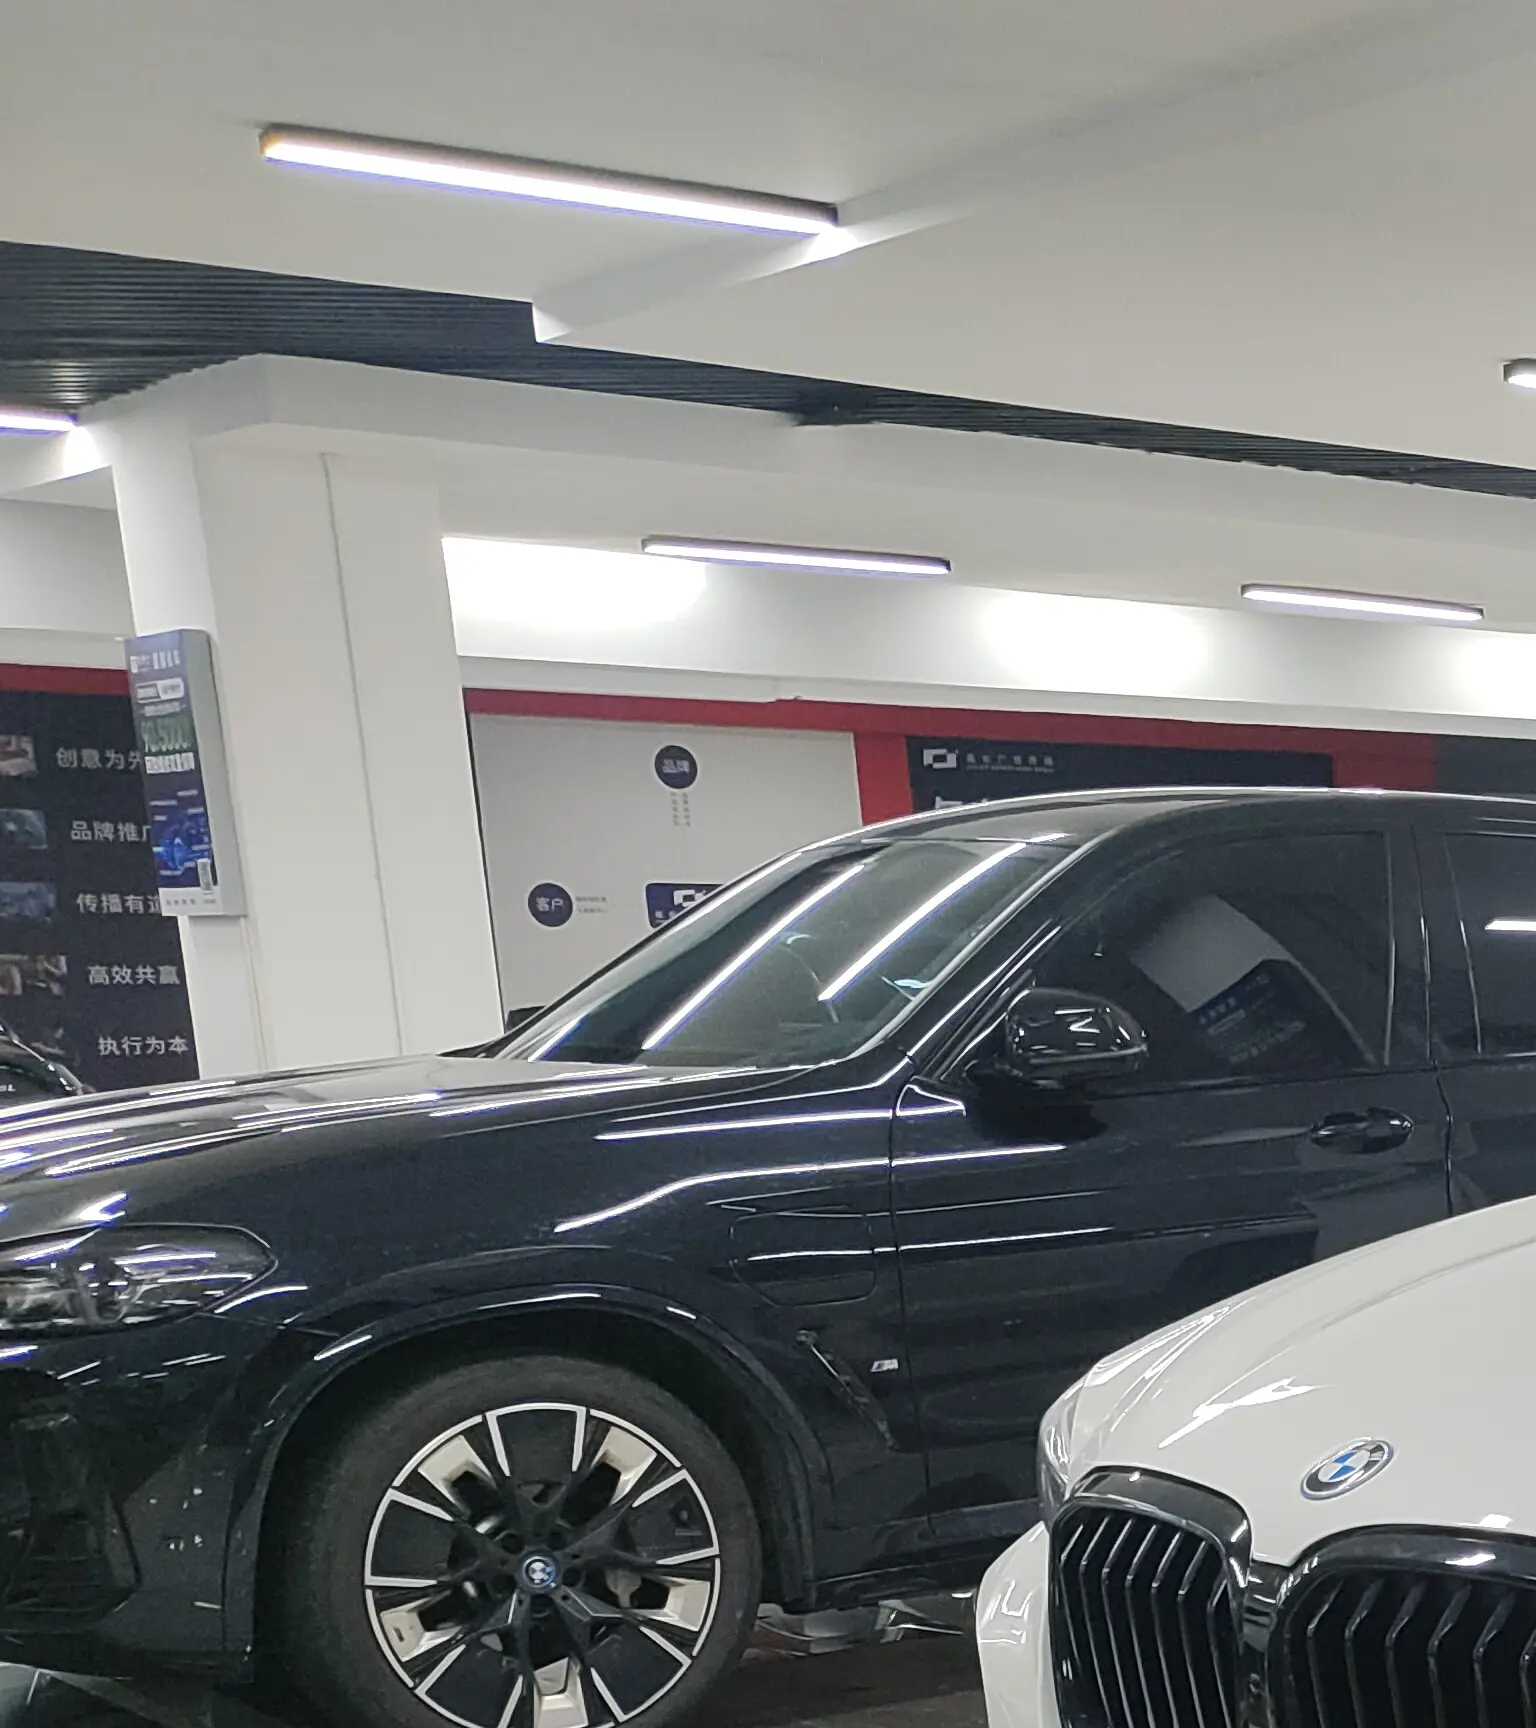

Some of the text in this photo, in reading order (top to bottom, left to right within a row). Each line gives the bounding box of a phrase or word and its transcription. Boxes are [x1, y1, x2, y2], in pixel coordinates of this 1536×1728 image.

[55, 747, 143, 771] 创意为先
[536, 896, 564, 912] 客户
[88, 964, 180, 986] 高效共赢
[97, 1035, 188, 1058] 执行为本
